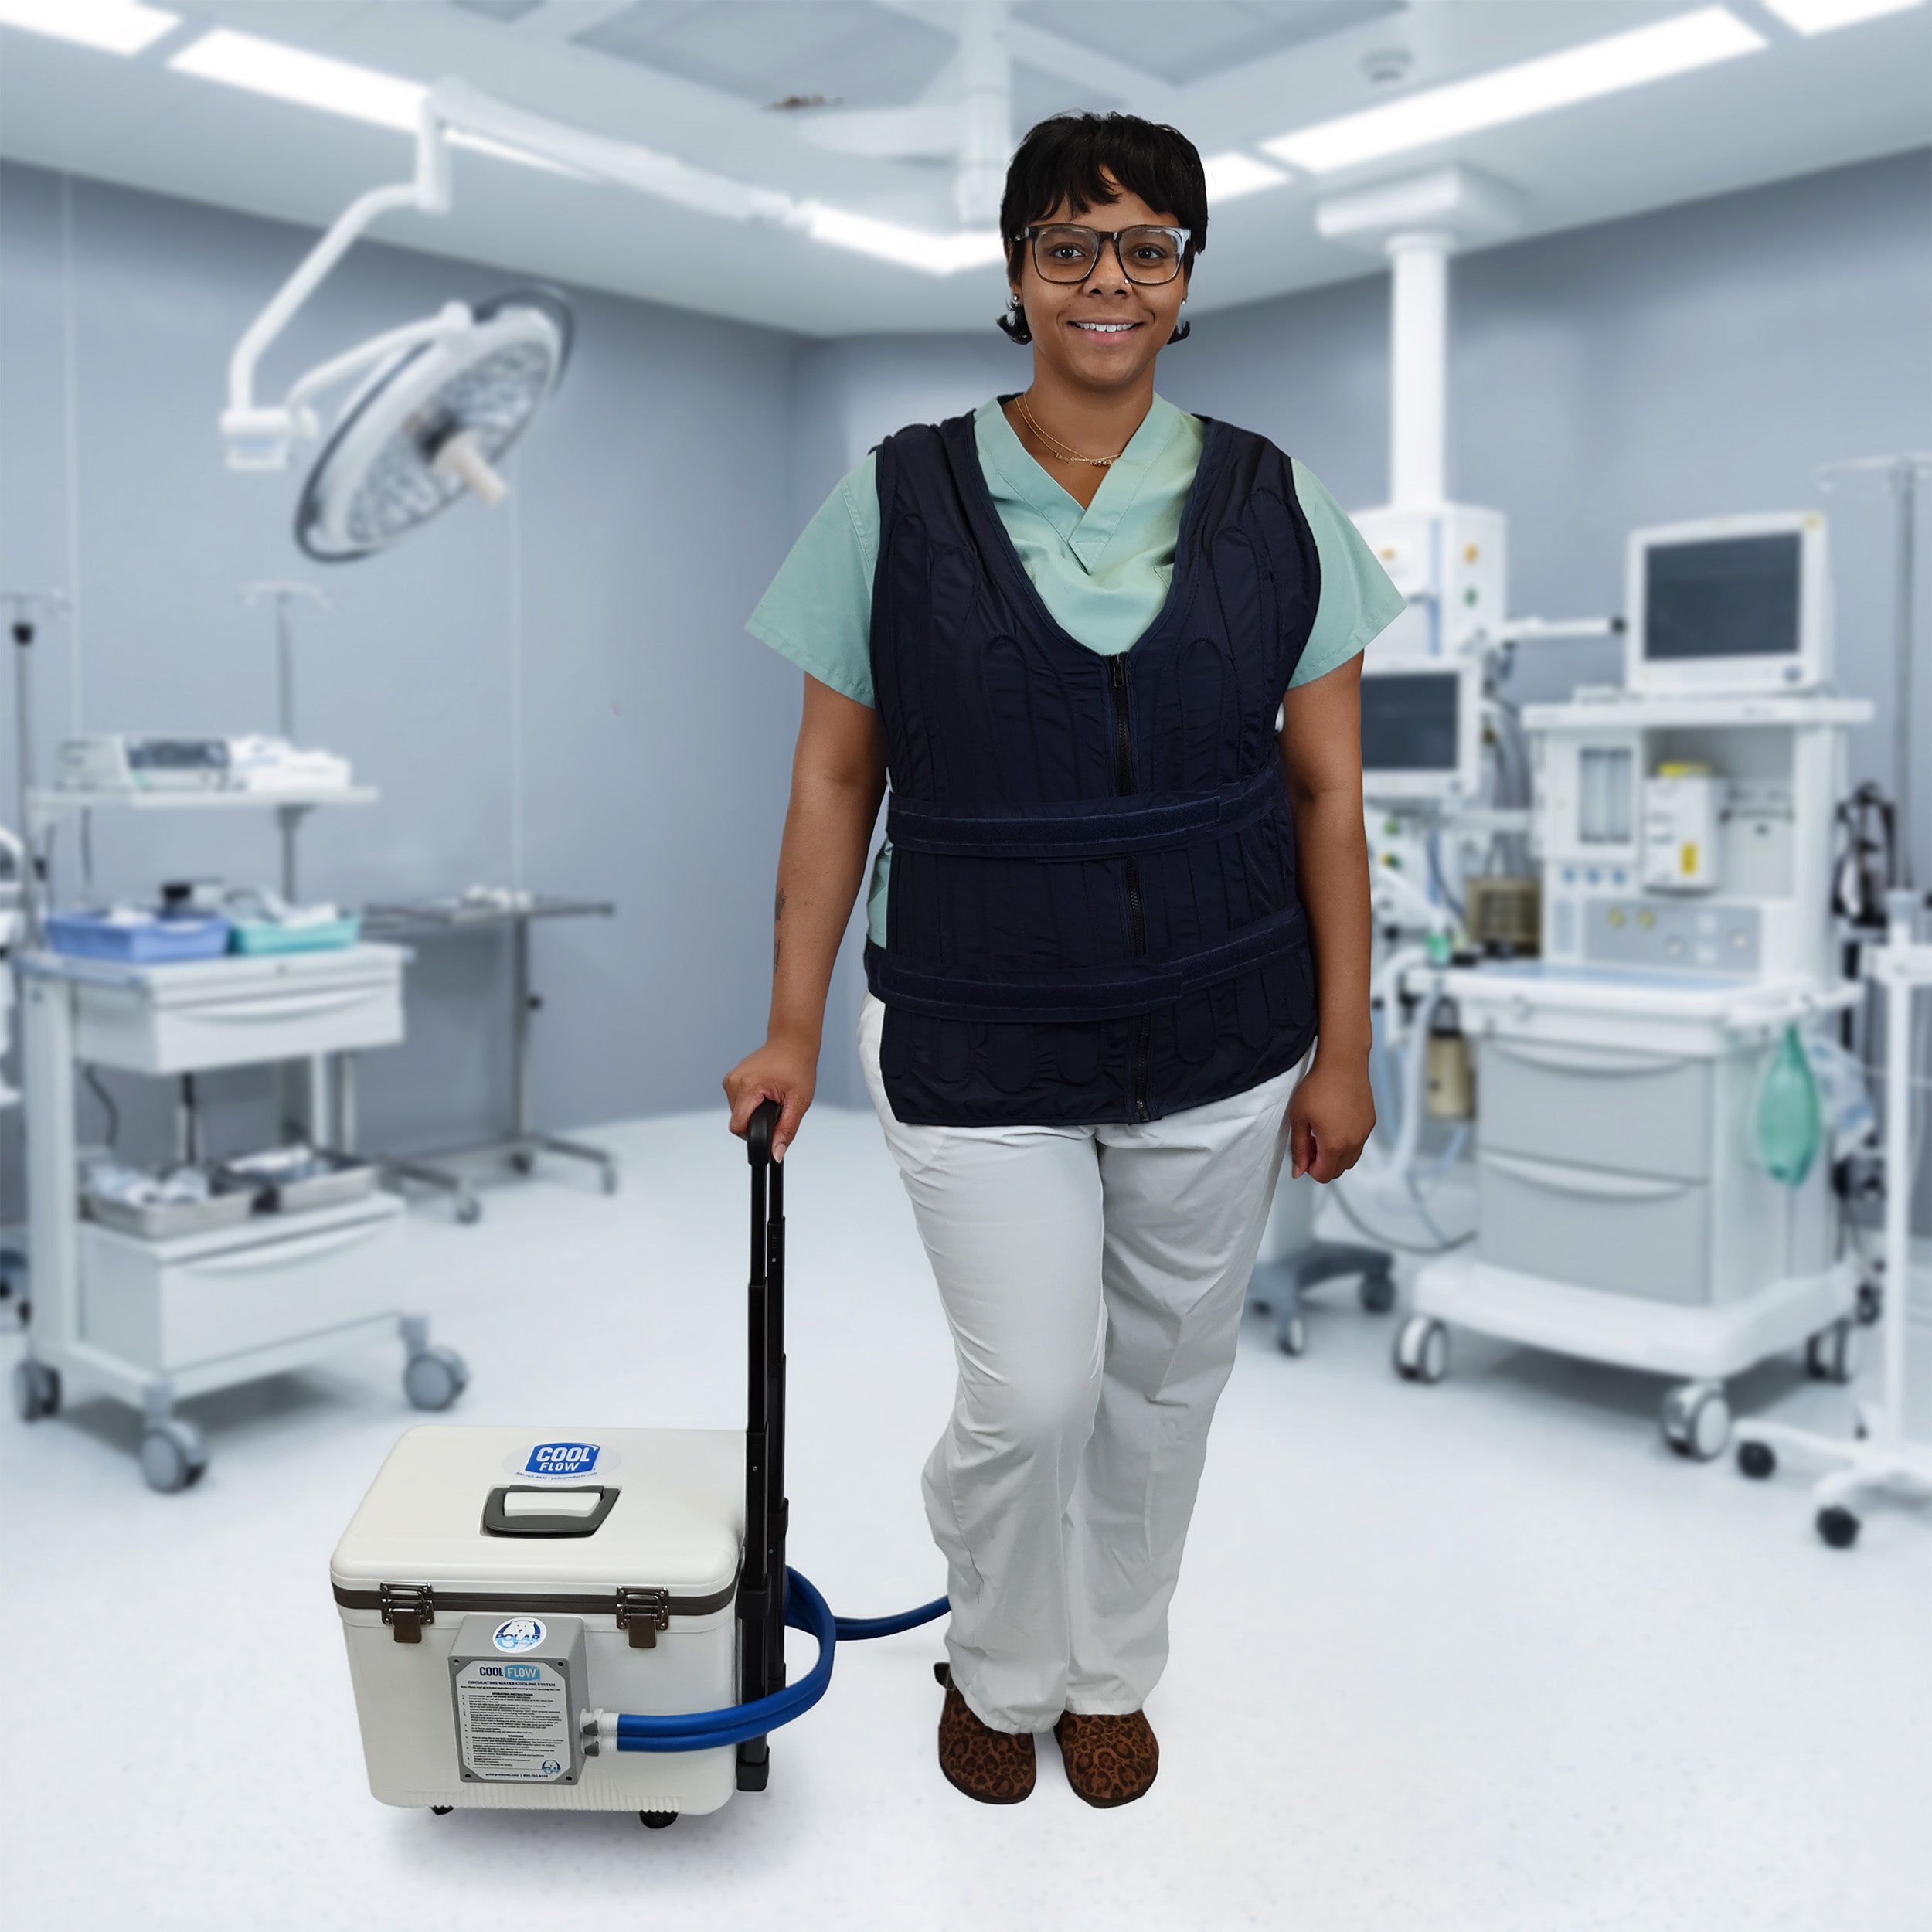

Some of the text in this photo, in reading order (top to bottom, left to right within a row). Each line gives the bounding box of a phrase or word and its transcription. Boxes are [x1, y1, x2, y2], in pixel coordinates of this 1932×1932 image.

[536, 1447, 590, 1462] COOL
[539, 1462, 580, 1471] FLOW
[479, 1666, 537, 1678] COOL FLOW
